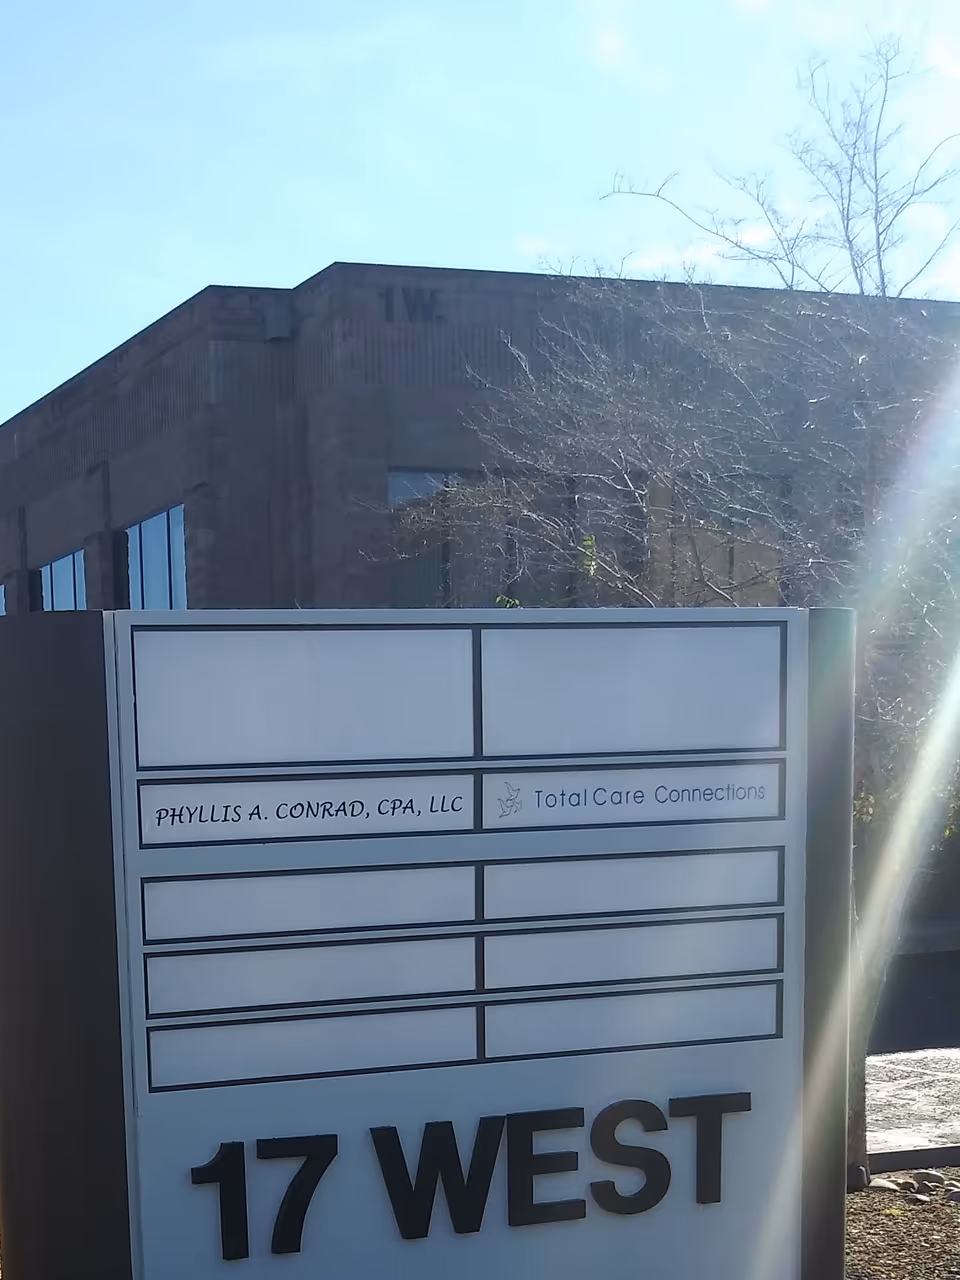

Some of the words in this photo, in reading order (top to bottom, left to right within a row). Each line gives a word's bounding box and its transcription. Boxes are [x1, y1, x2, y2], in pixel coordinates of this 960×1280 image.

[155, 804, 242, 827] PHYLLIS
[248, 804, 268, 821] A.
[275, 800, 371, 820] CONRAD,
[377, 797, 422, 817] CPA,
[429, 795, 463, 813] LLC
[534, 787, 588, 809] Total
[592, 787, 645, 806] Care
[654, 783, 766, 804] Connections
[190, 1133, 339, 1262] 17
[369, 1091, 752, 1241] WEST
